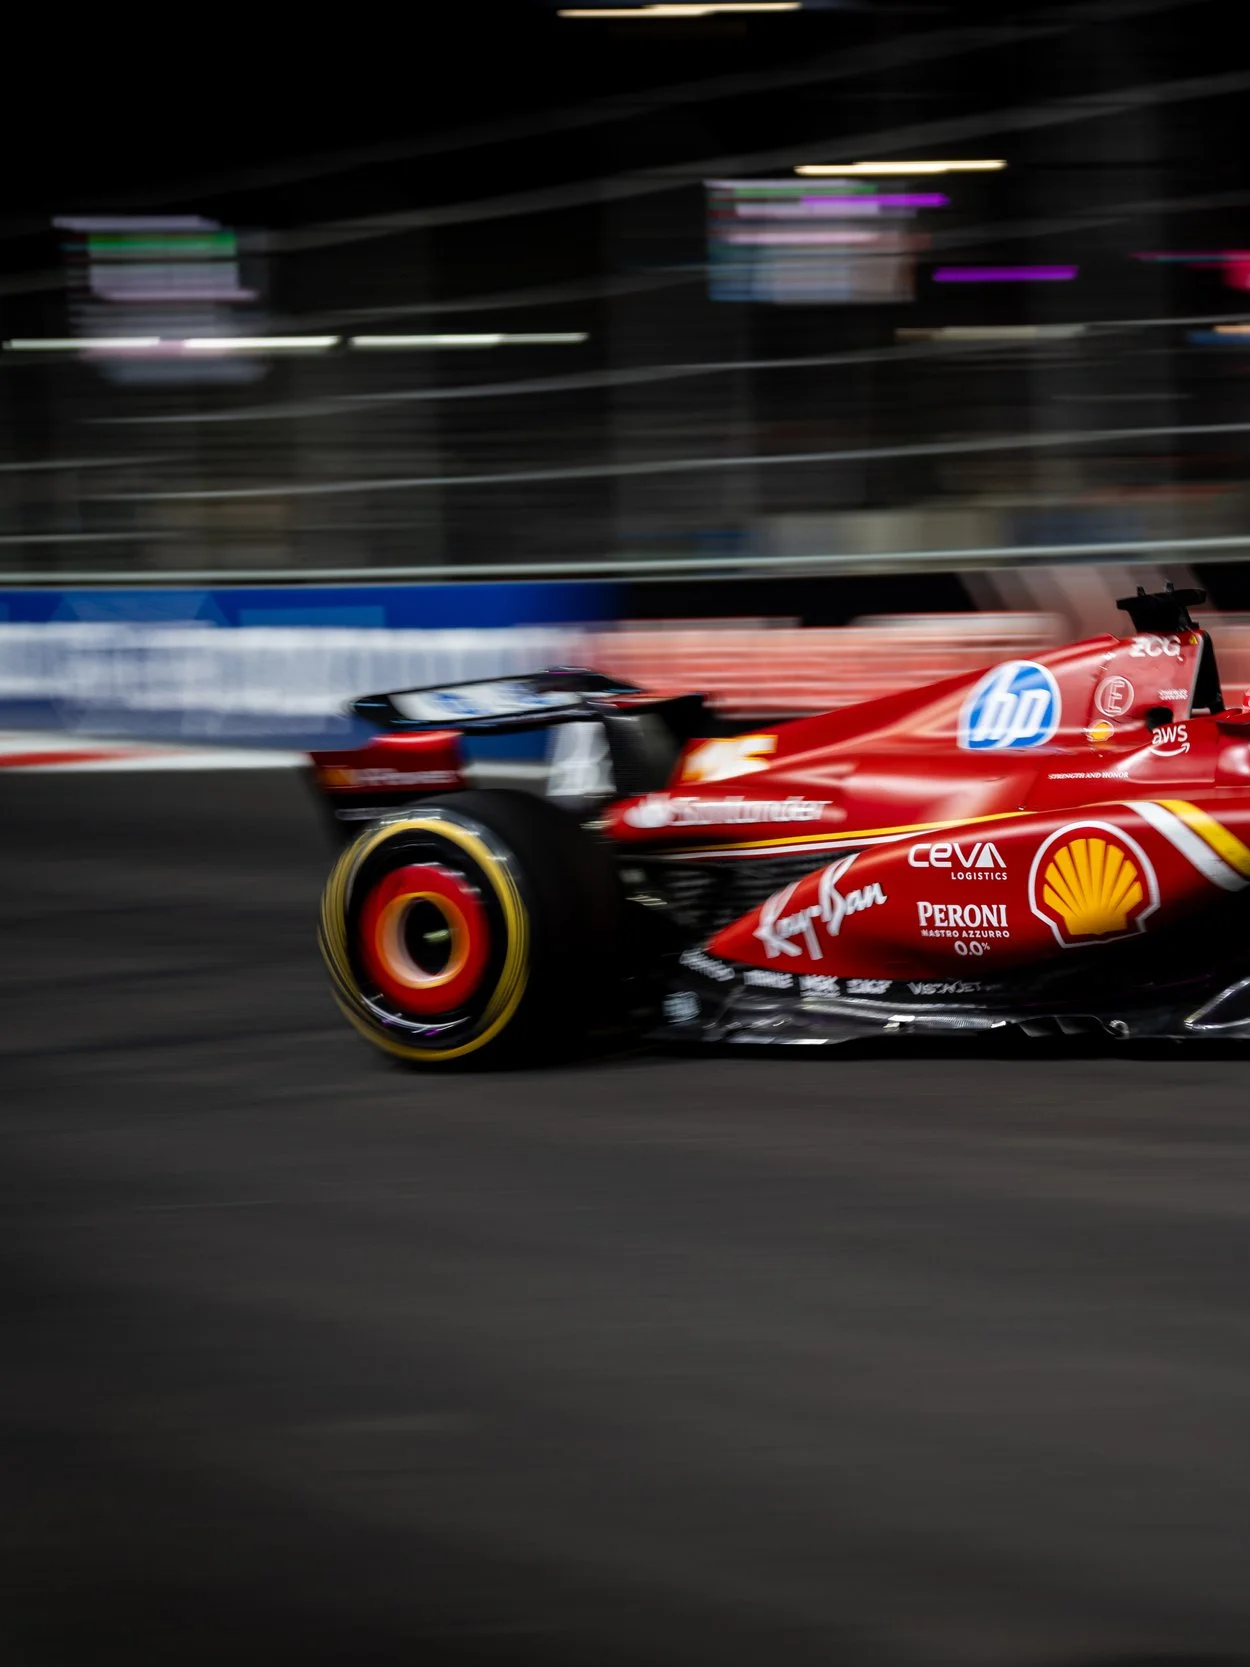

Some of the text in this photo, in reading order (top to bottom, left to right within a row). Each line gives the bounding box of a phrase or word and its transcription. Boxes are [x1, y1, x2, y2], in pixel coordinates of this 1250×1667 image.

[966, 661, 1054, 749] hp
[1151, 723, 1189, 746] aws
[1048, 772, 1083, 780] STRENGTH
[1101, 771, 1129, 779] HONOR
[950, 871, 1008, 881] LOGISTICS
[916, 900, 1009, 928] PERONI
[920, 929, 1010, 938] MASTRO AZZURRO
